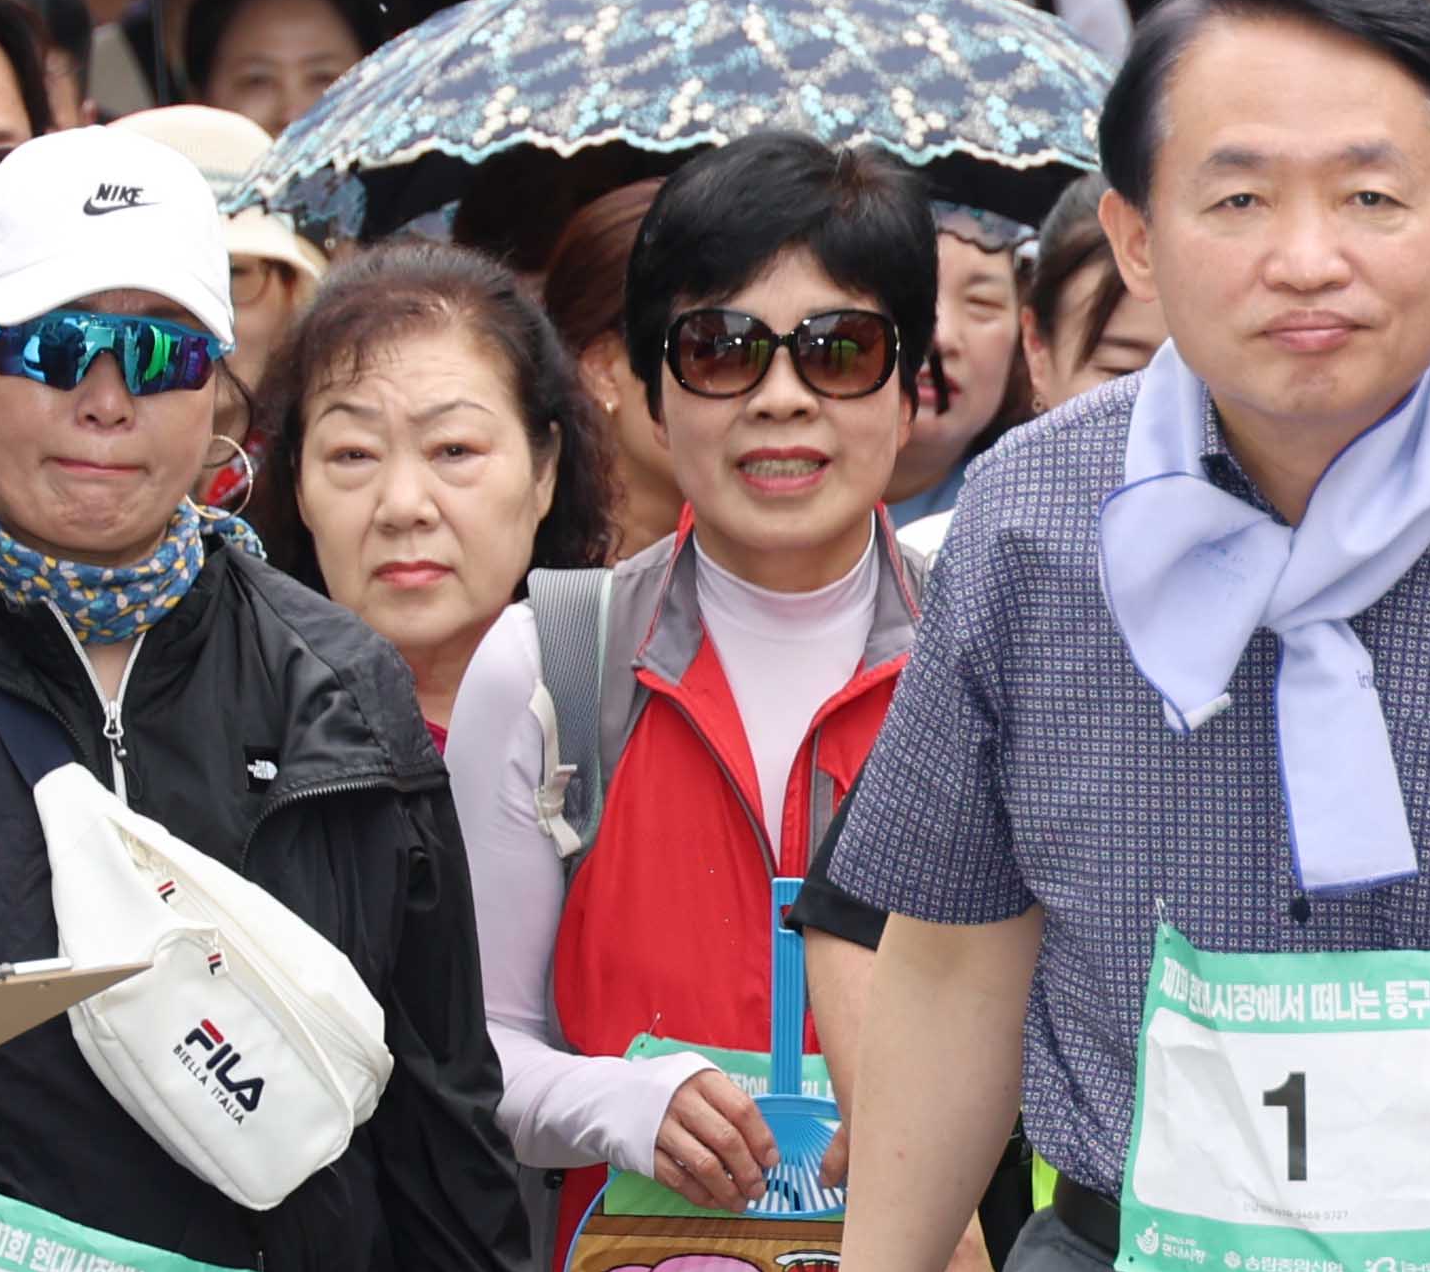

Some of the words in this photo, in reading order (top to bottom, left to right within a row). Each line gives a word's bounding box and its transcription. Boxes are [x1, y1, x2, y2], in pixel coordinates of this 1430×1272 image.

[95, 182, 144, 203] NIKE
[1311, 981, 1381, 1023] 떠나는
[172, 1043, 209, 1087] BIELLA
[210, 1086, 245, 1126] ITALIA
[184, 1018, 265, 1113] FILA
[1262, 1070, 1308, 1182] 1
